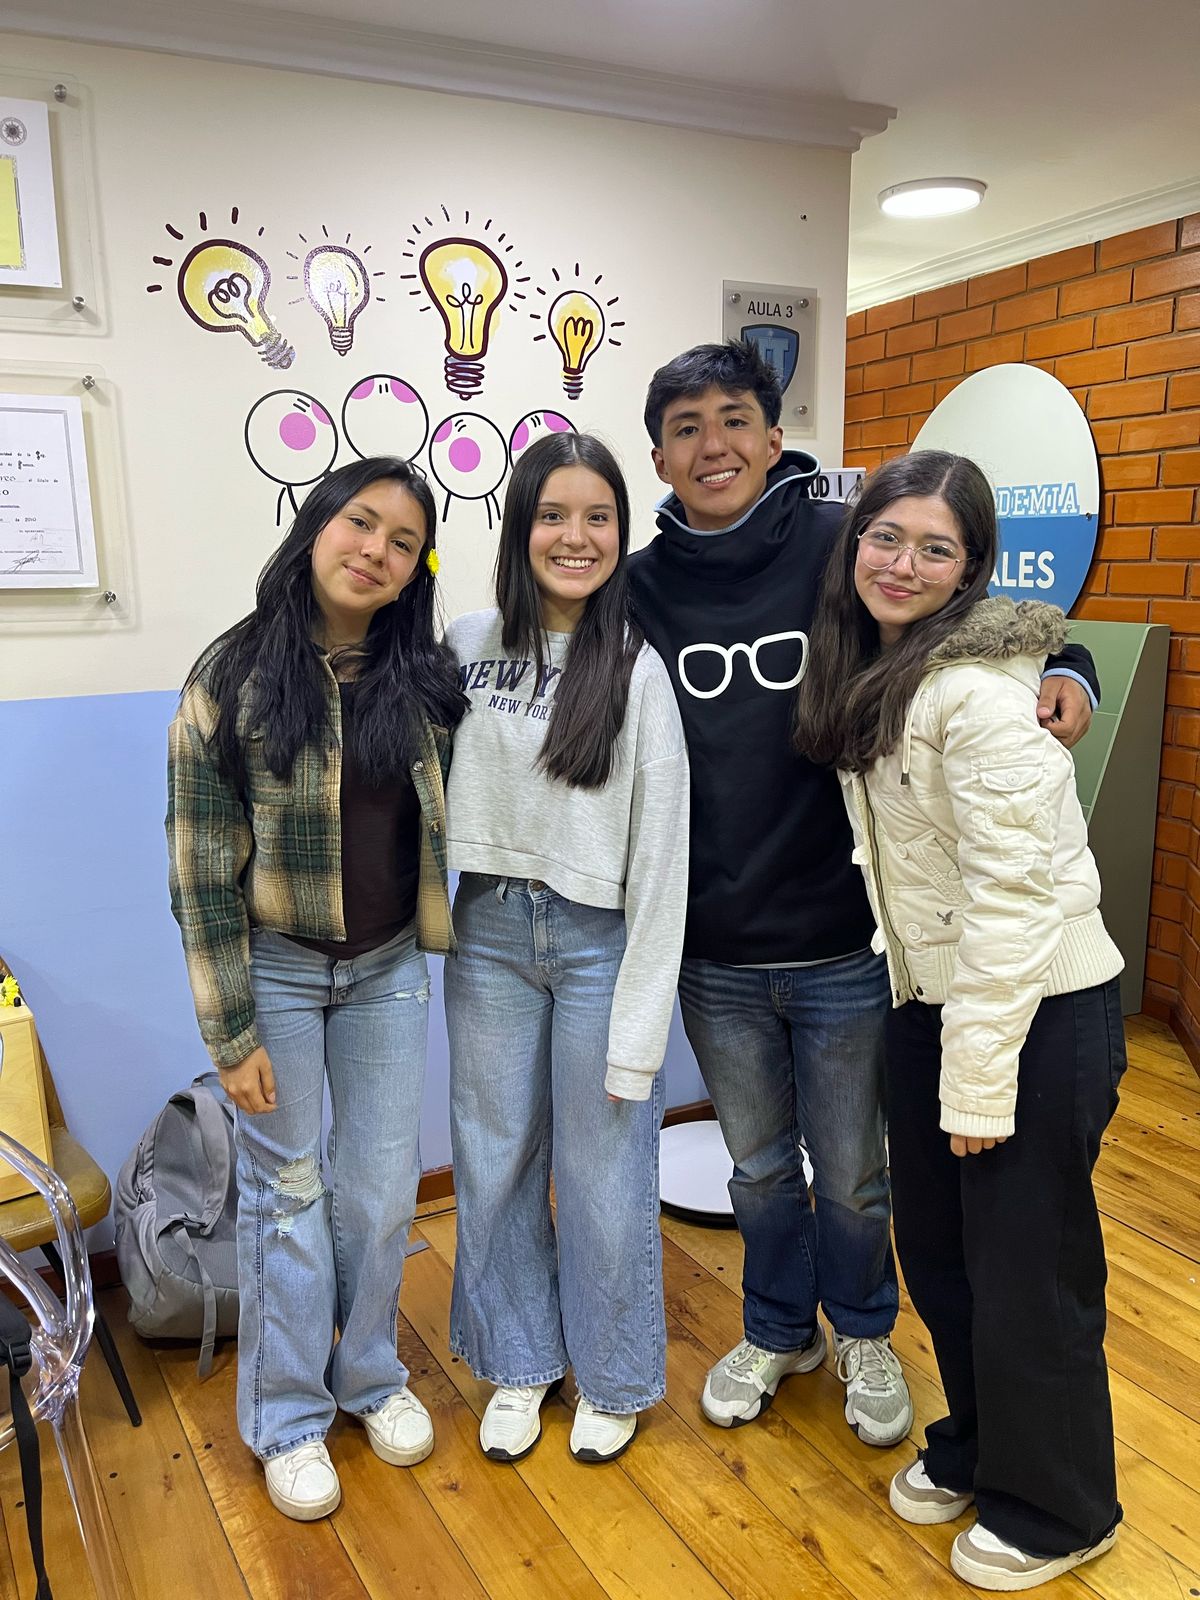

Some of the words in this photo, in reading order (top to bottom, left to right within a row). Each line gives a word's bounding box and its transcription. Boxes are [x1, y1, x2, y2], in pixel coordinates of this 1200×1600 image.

[747, 300, 782, 318] AULA
[785, 305, 793, 318] 3
[997, 483, 1079, 517] DEMIA
[458, 660, 531, 692] NEW
[488, 695, 521, 714] NEW
